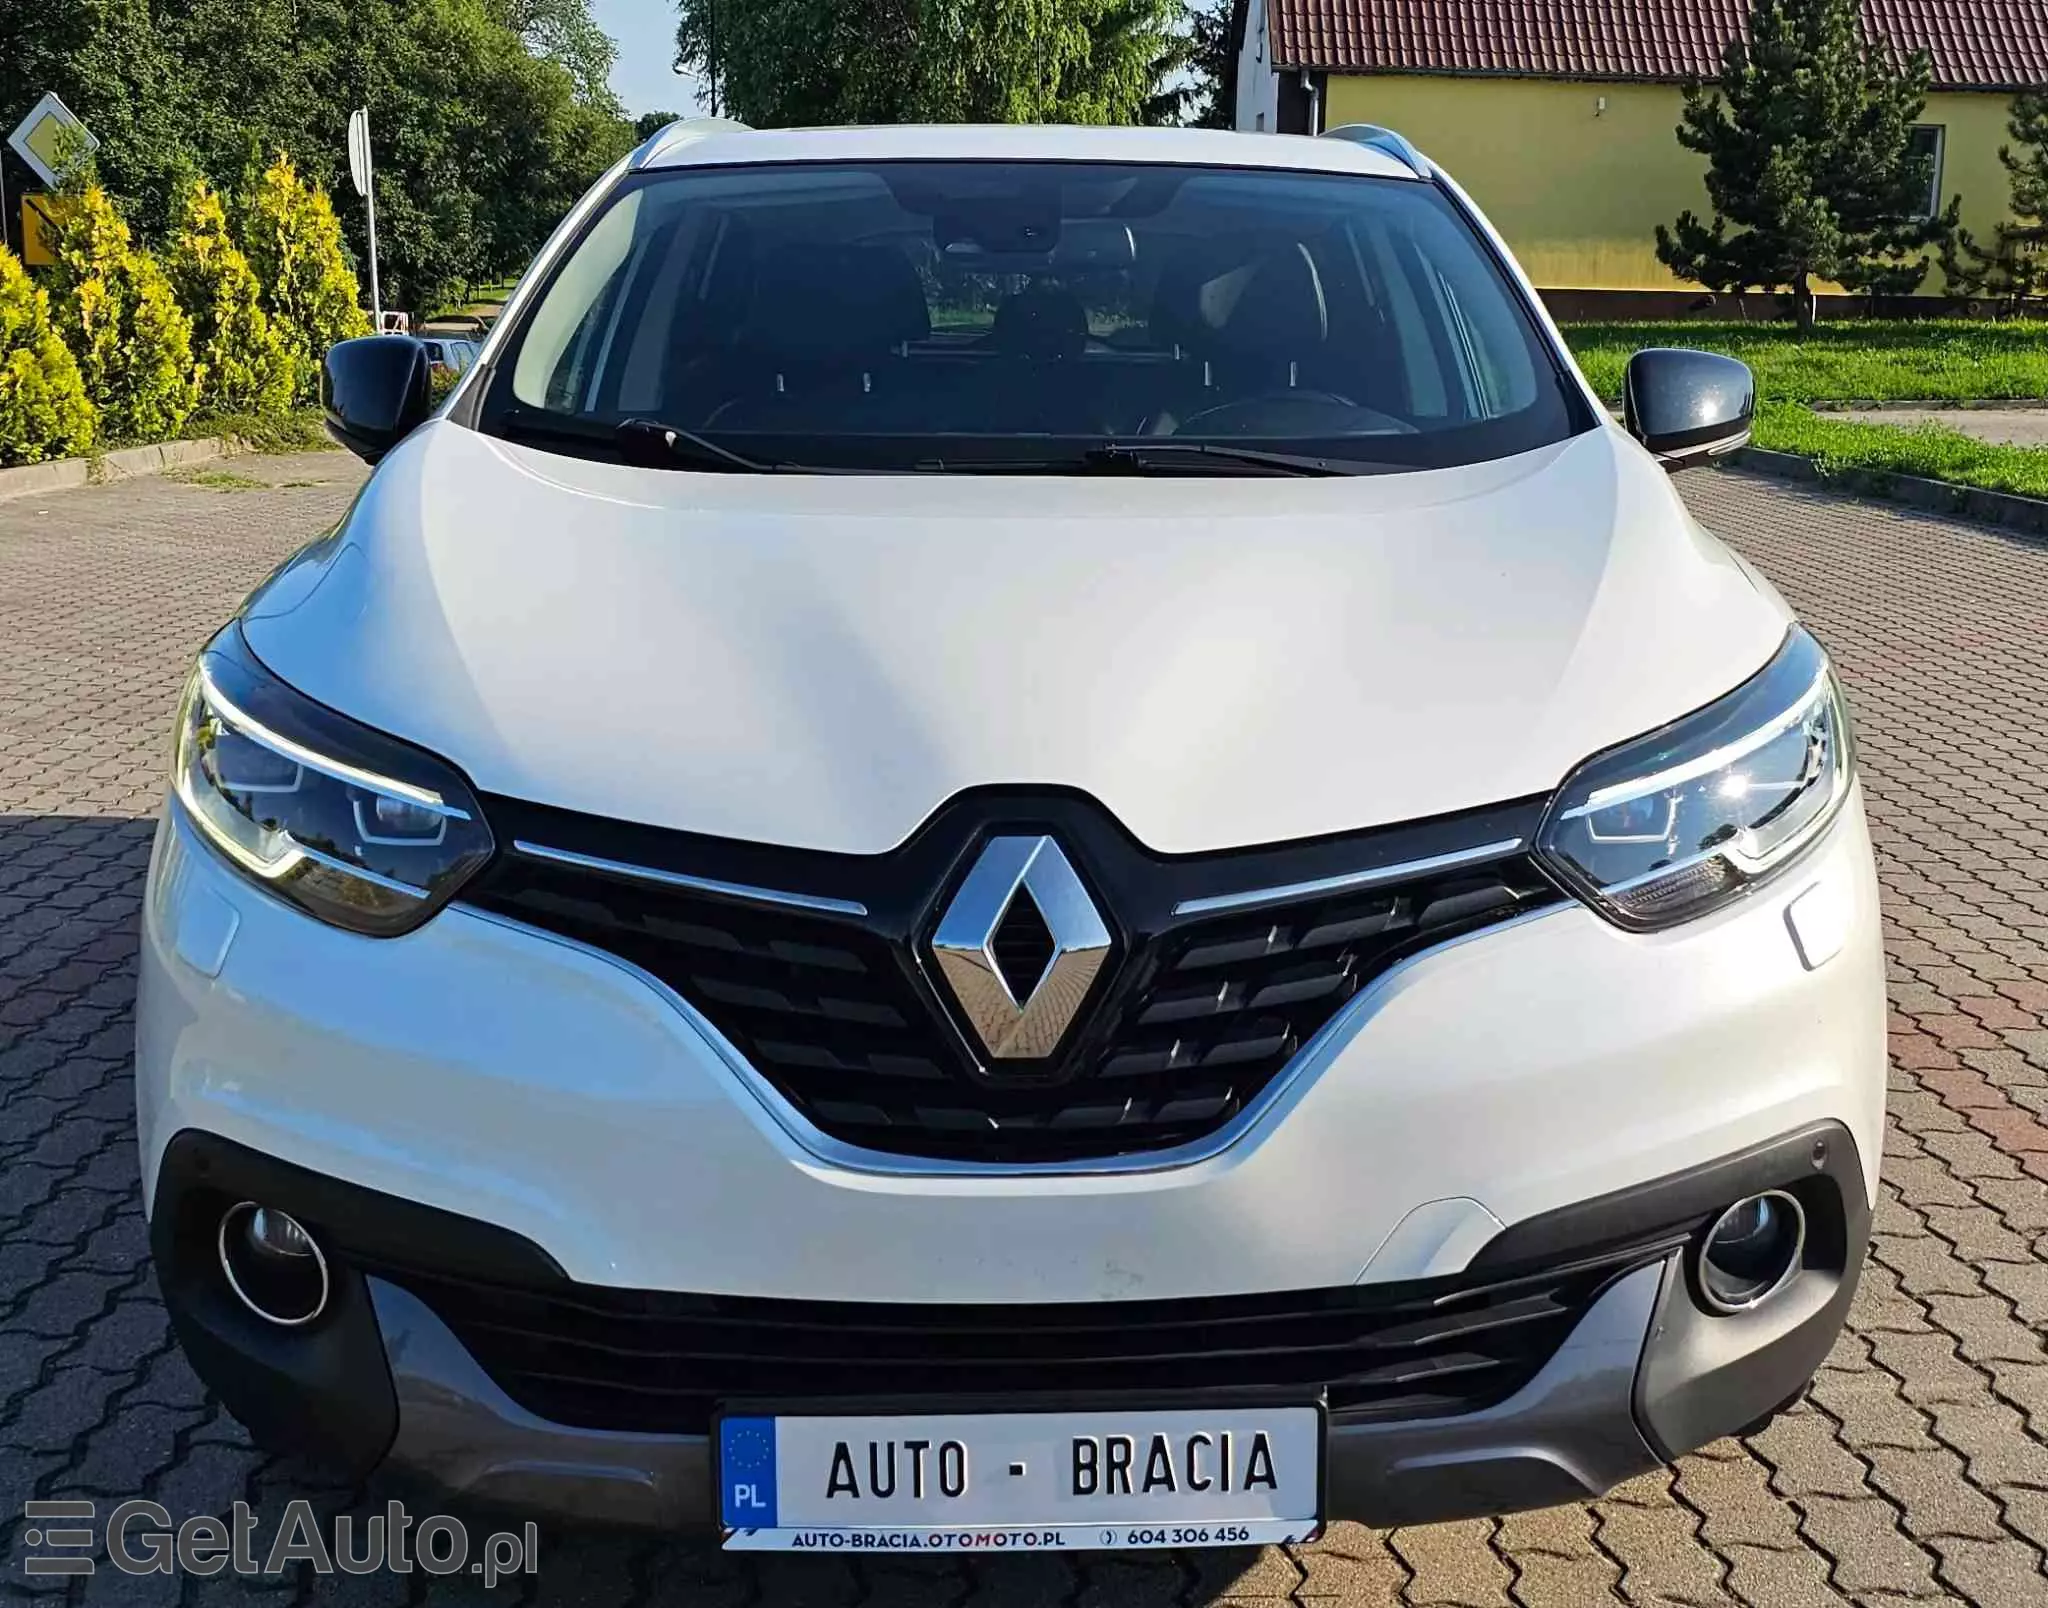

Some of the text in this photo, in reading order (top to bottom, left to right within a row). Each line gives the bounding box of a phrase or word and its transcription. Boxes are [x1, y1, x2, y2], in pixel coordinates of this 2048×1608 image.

[825, 1441, 967, 1498] AUTO
[1072, 1431, 1278, 1494] BRACIA
[734, 1484, 766, 1507] PL
[792, 1531, 1065, 1548] AUTO-BRACIA.OTOMOTO.PL
[1127, 1526, 1250, 1544] 604 306 456
